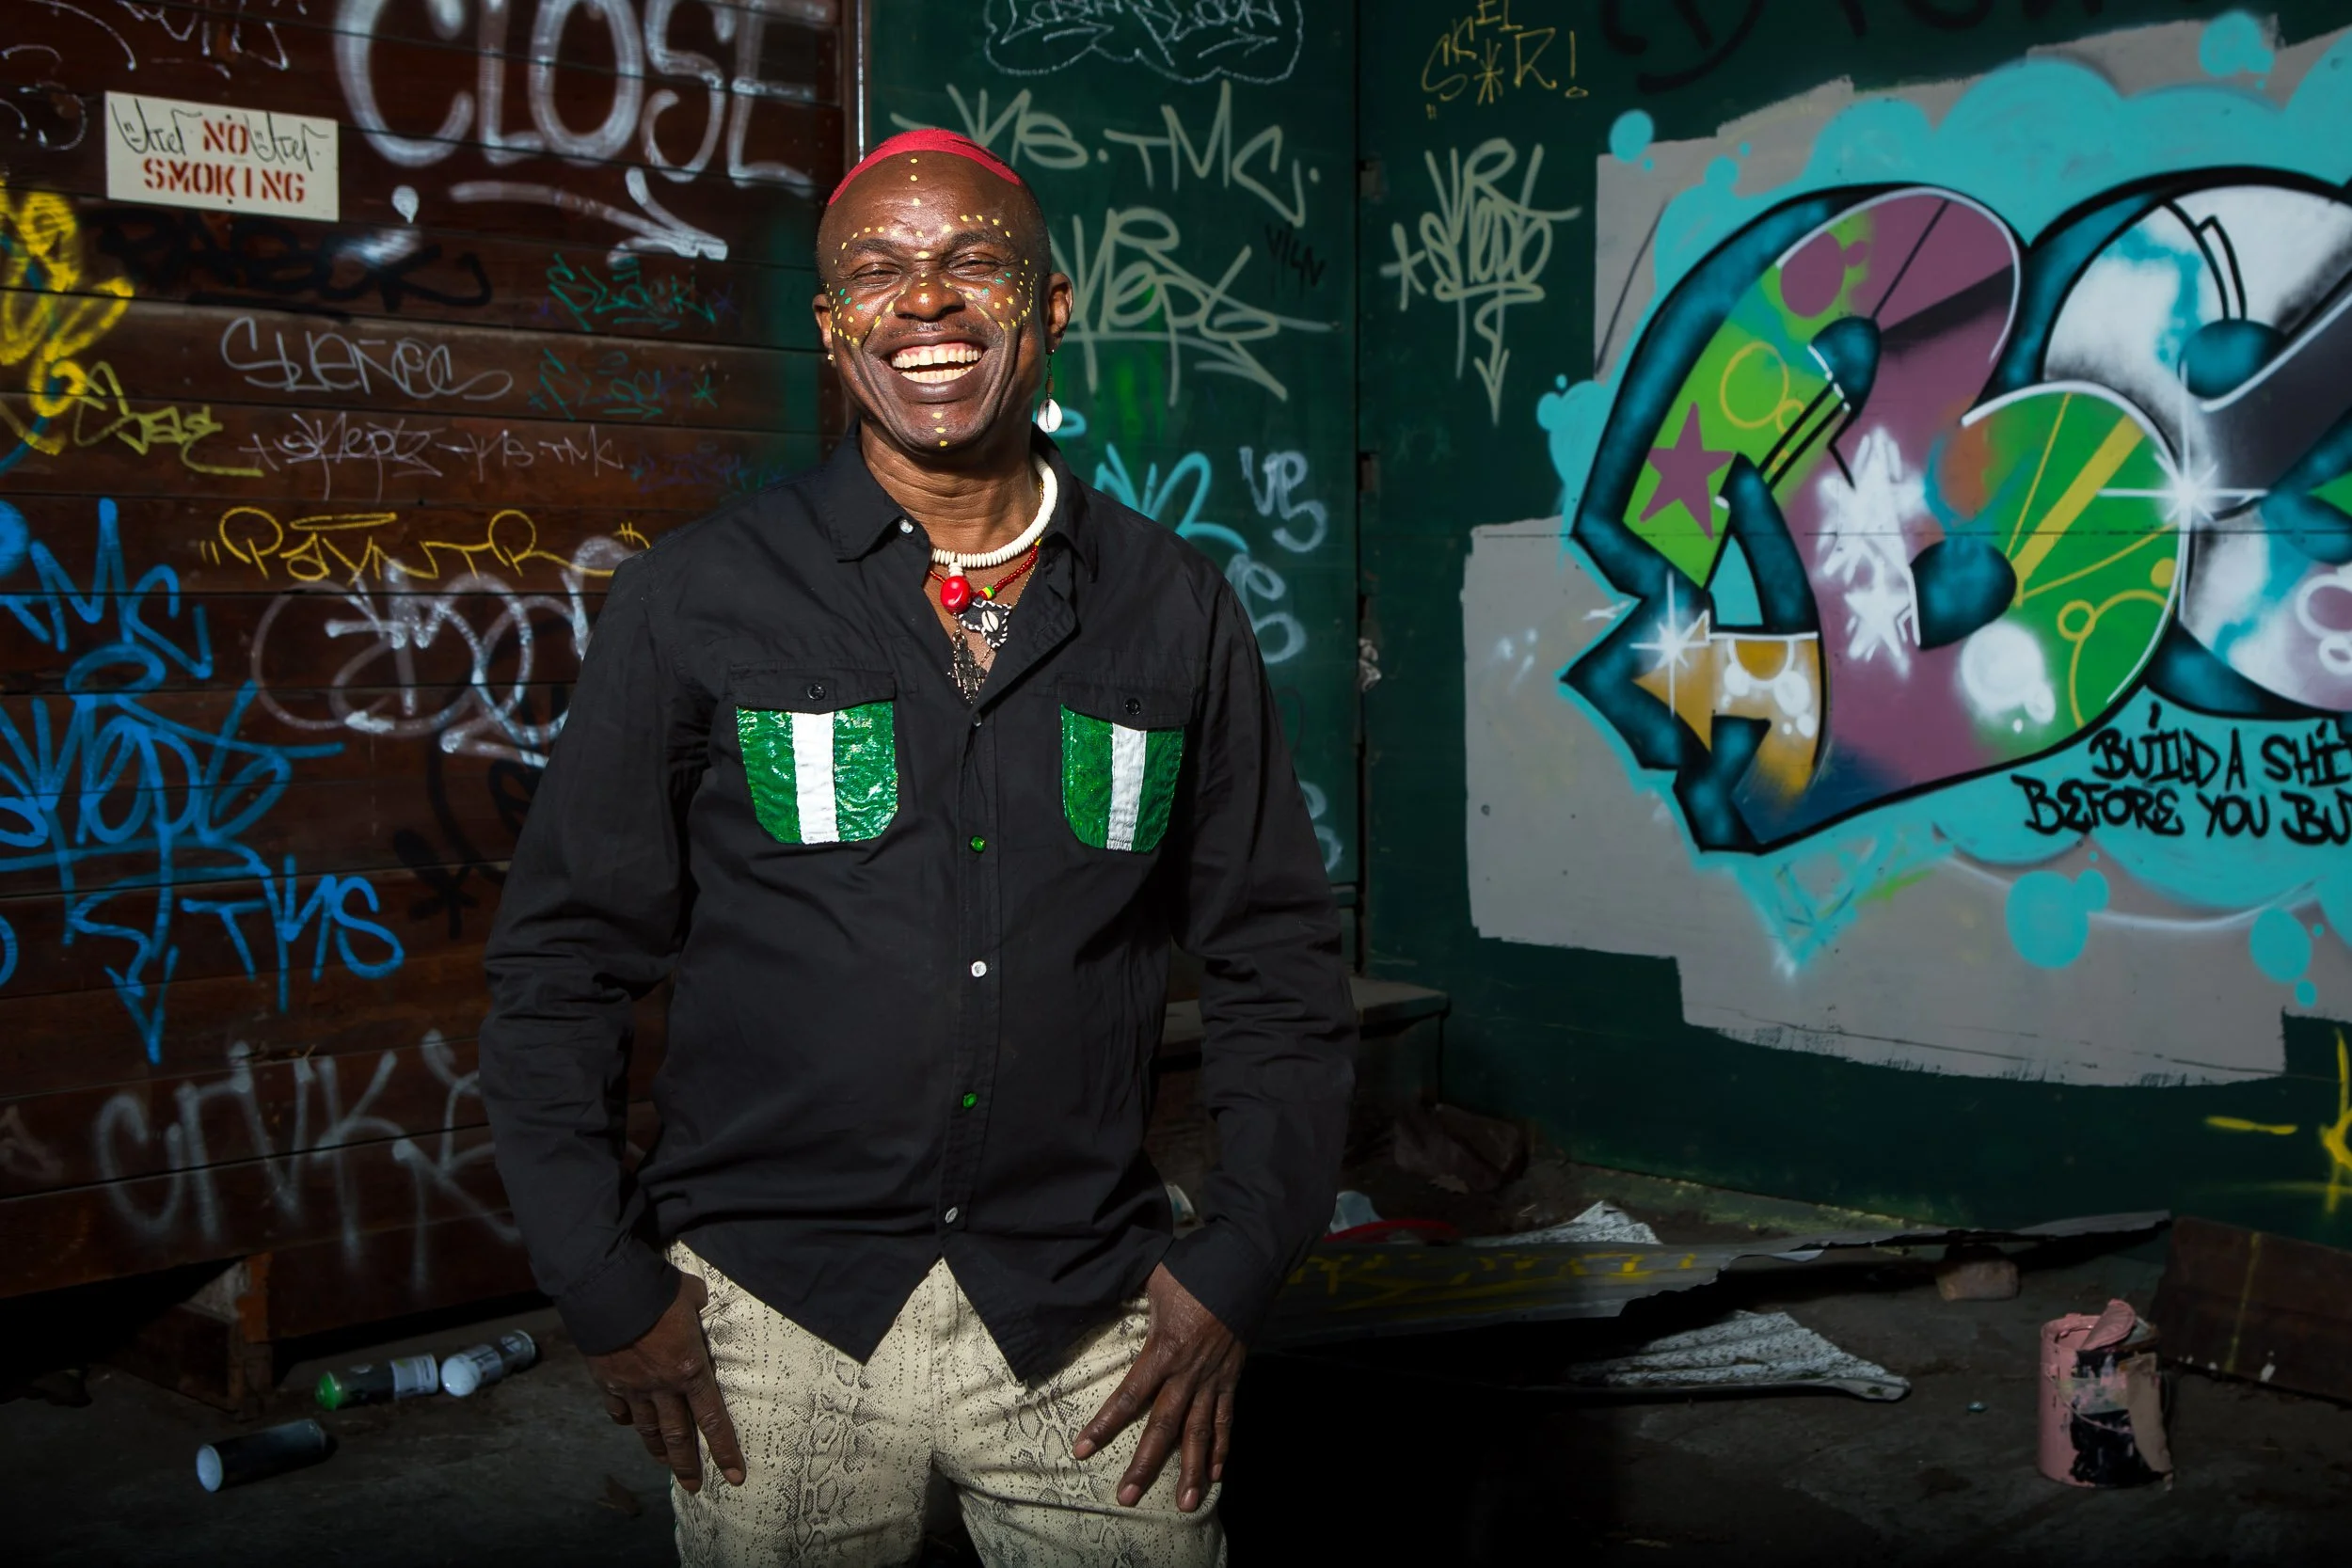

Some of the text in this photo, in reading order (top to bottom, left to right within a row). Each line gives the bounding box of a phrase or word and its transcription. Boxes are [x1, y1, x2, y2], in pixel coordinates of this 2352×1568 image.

[333, 0, 815, 196] CLOSE
[203, 119, 249, 155] NO
[143, 157, 305, 203] SMOKING
[2089, 702, 2352, 791] BUILD A SHI
[2010, 773, 2352, 846] BEFORE YOU BU
